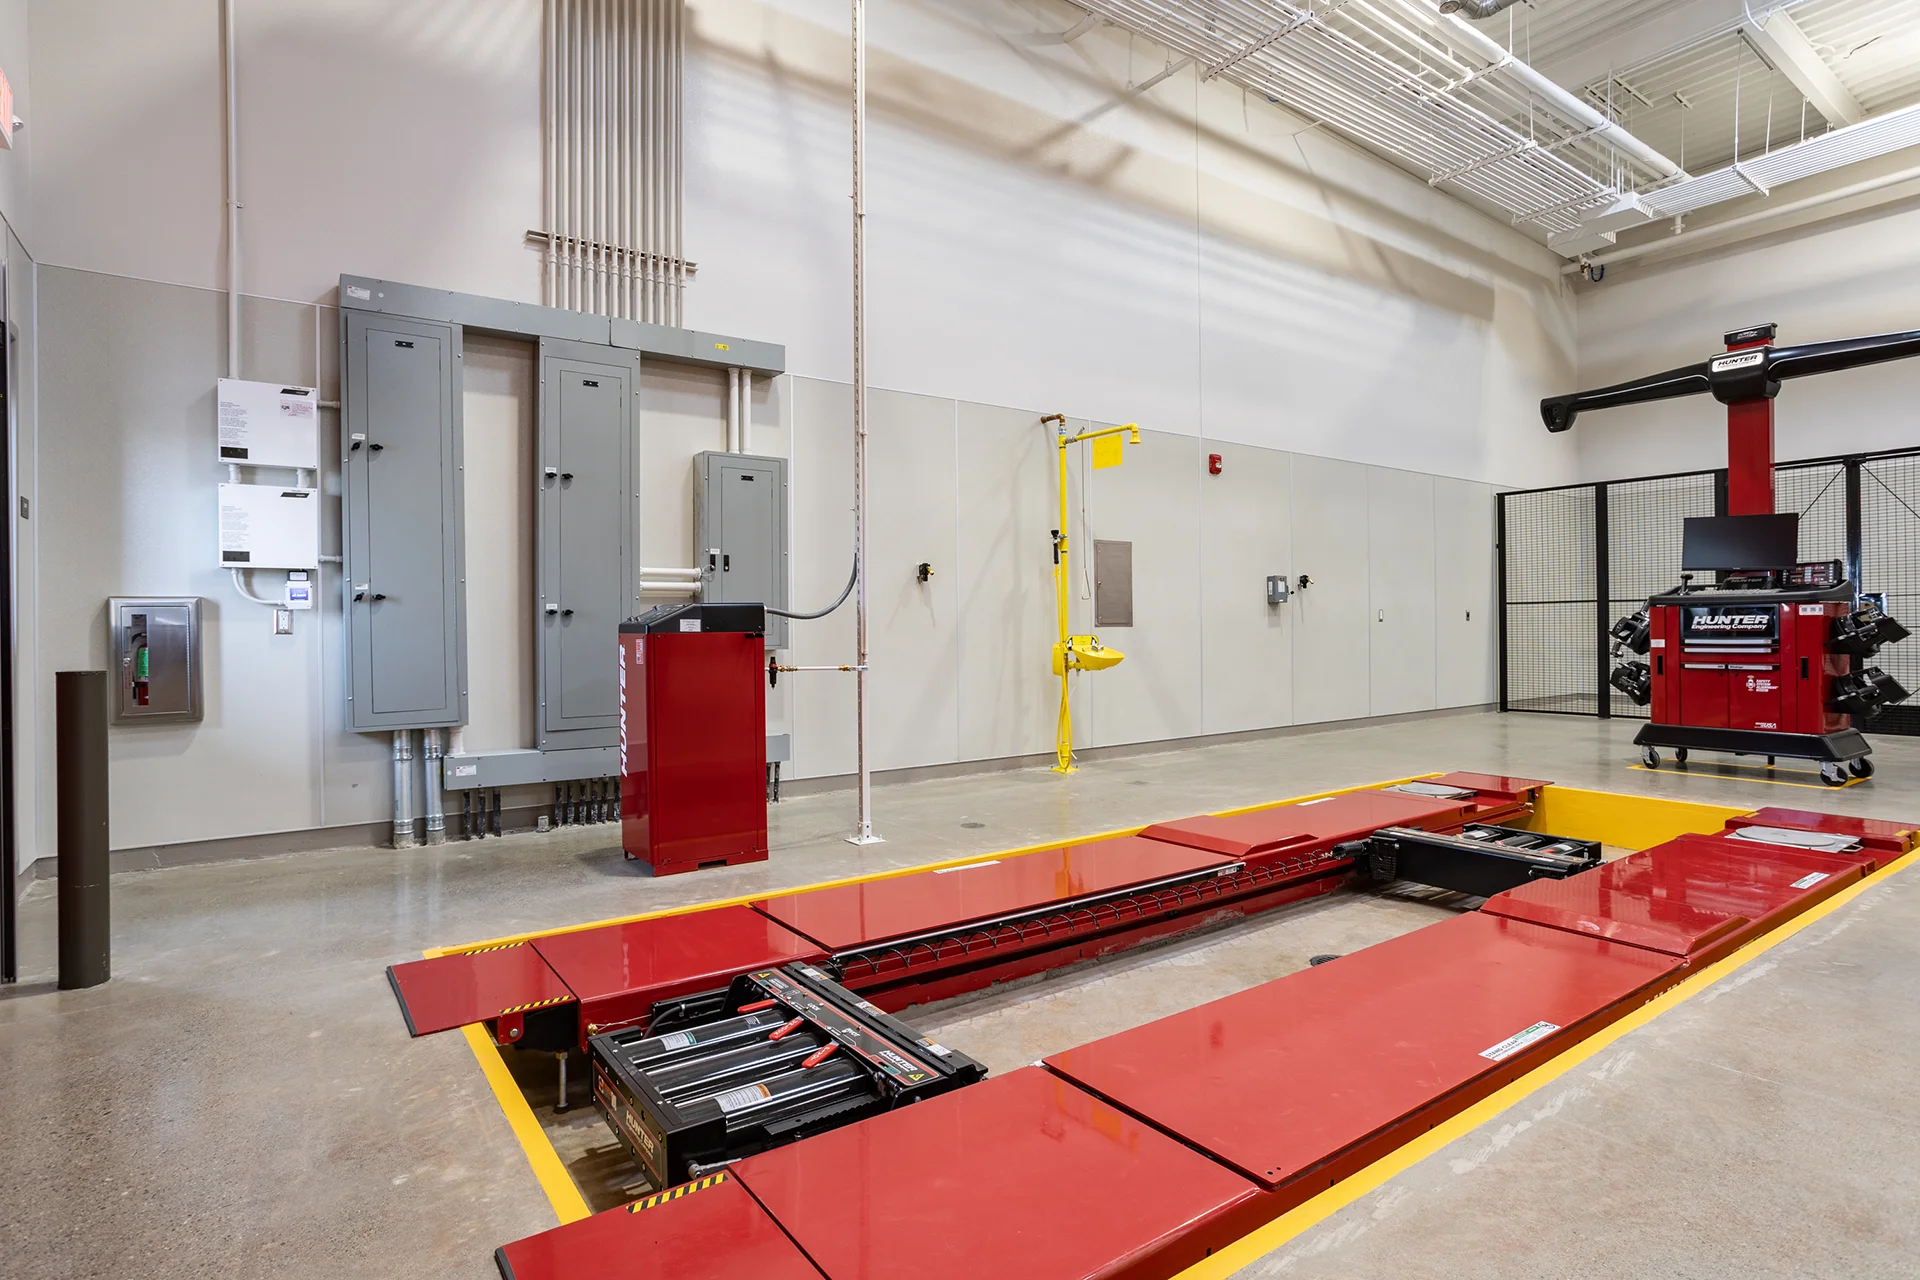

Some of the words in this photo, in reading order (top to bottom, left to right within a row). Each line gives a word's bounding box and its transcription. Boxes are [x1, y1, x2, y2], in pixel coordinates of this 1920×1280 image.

[1718, 355, 1758, 366] HUNTER
[1693, 615, 1770, 624] HUNTER
[620, 644, 628, 777] HUNTER
[880, 1050, 918, 1072] HUNTER
[626, 1110, 654, 1154] HUNTER
